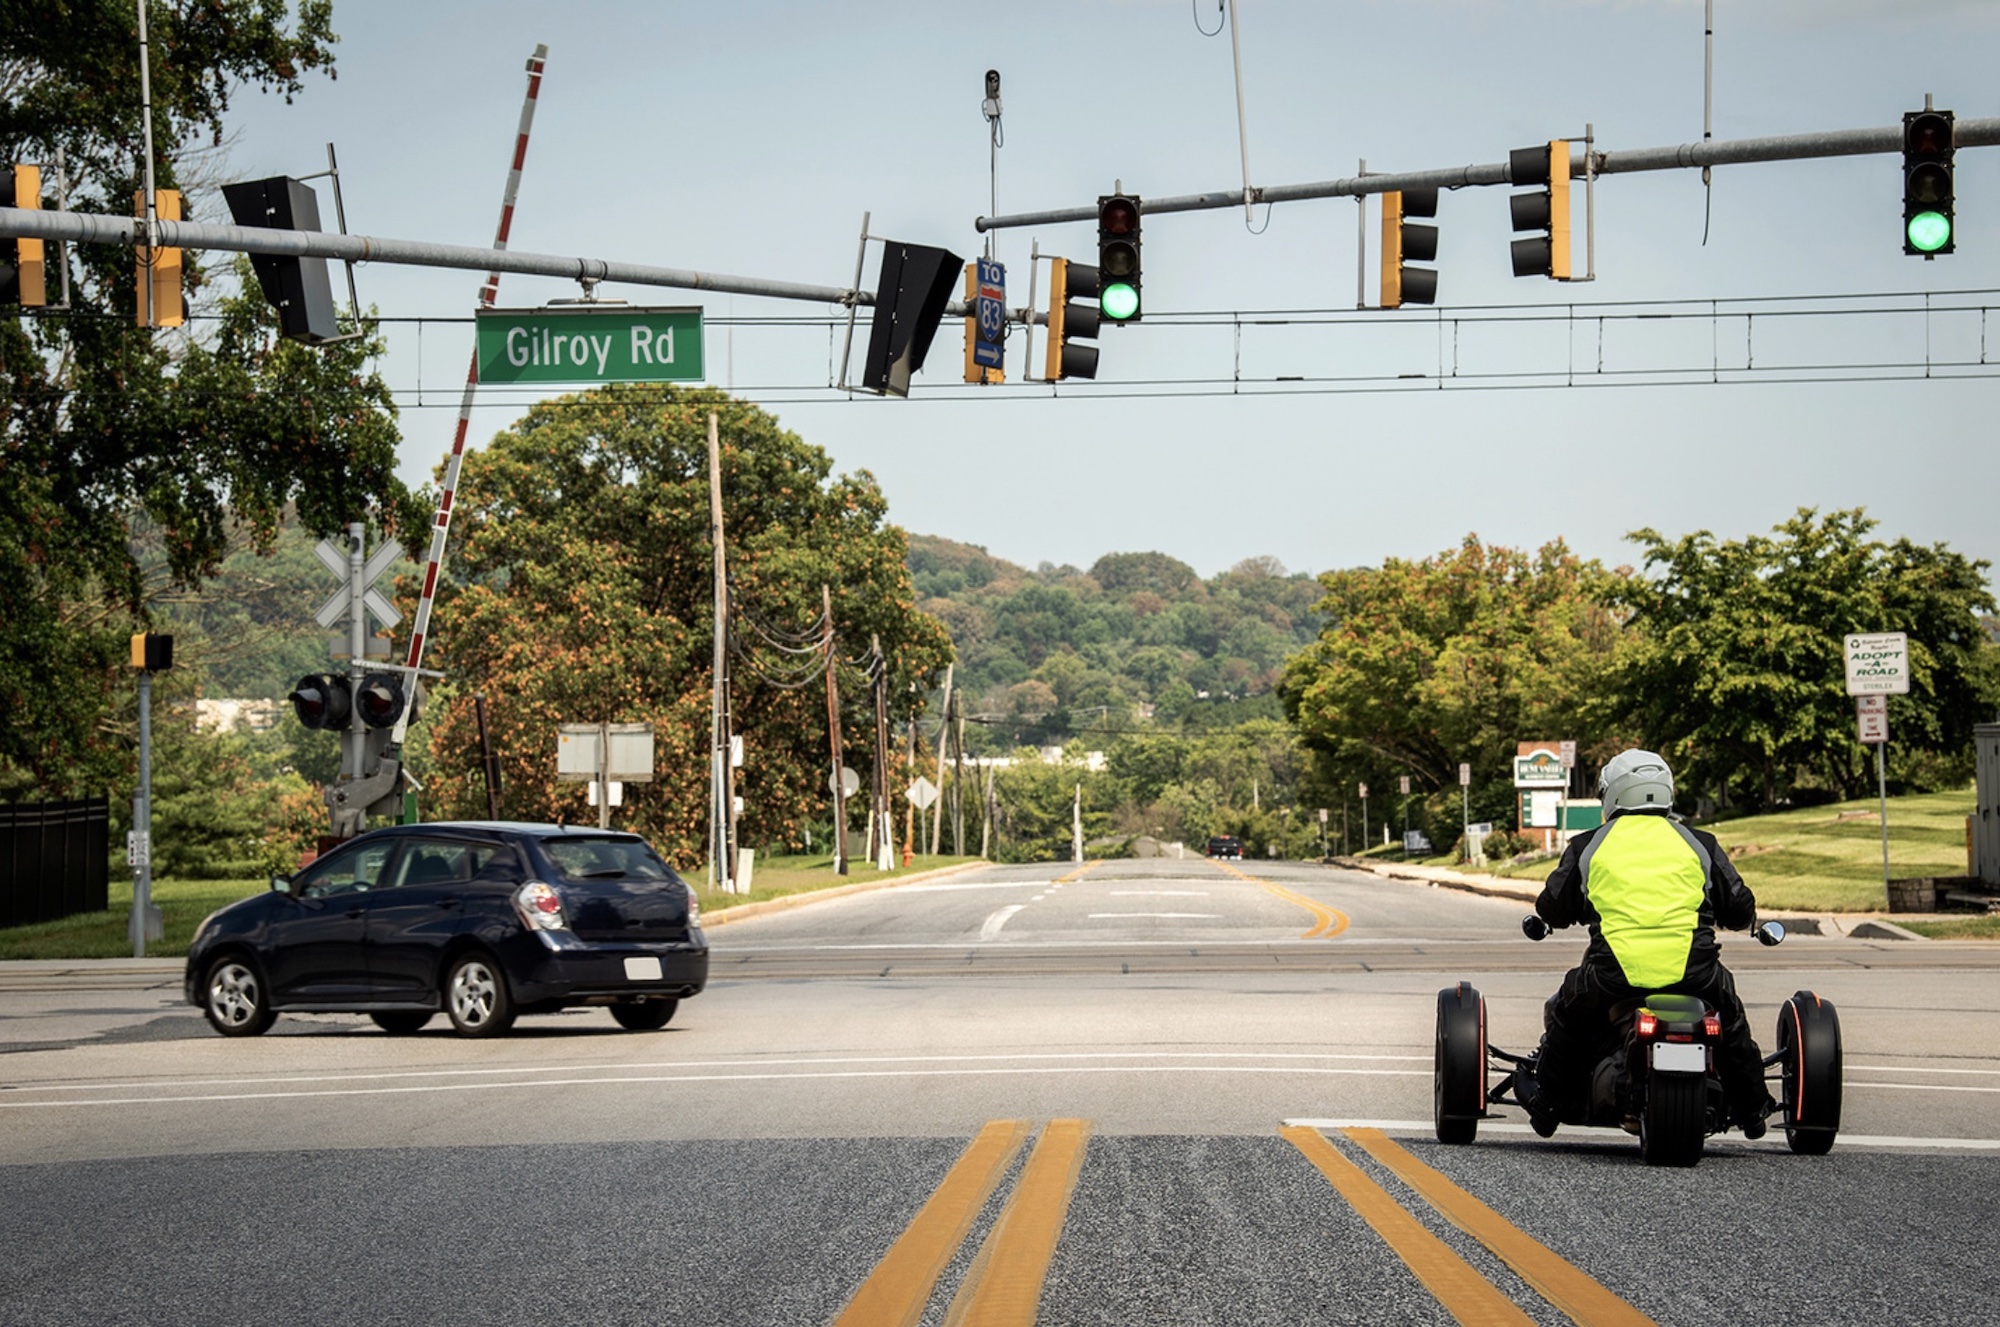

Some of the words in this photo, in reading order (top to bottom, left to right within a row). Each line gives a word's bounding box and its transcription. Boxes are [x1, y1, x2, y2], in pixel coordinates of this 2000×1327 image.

[982, 263, 1001, 283] TO
[982, 300, 1000, 331] 83
[507, 326, 612, 376] Gilroy
[631, 325, 675, 364] Rd
[1850, 651, 1903, 660] ADOPT
[1856, 668, 1899, 676] ROAD
